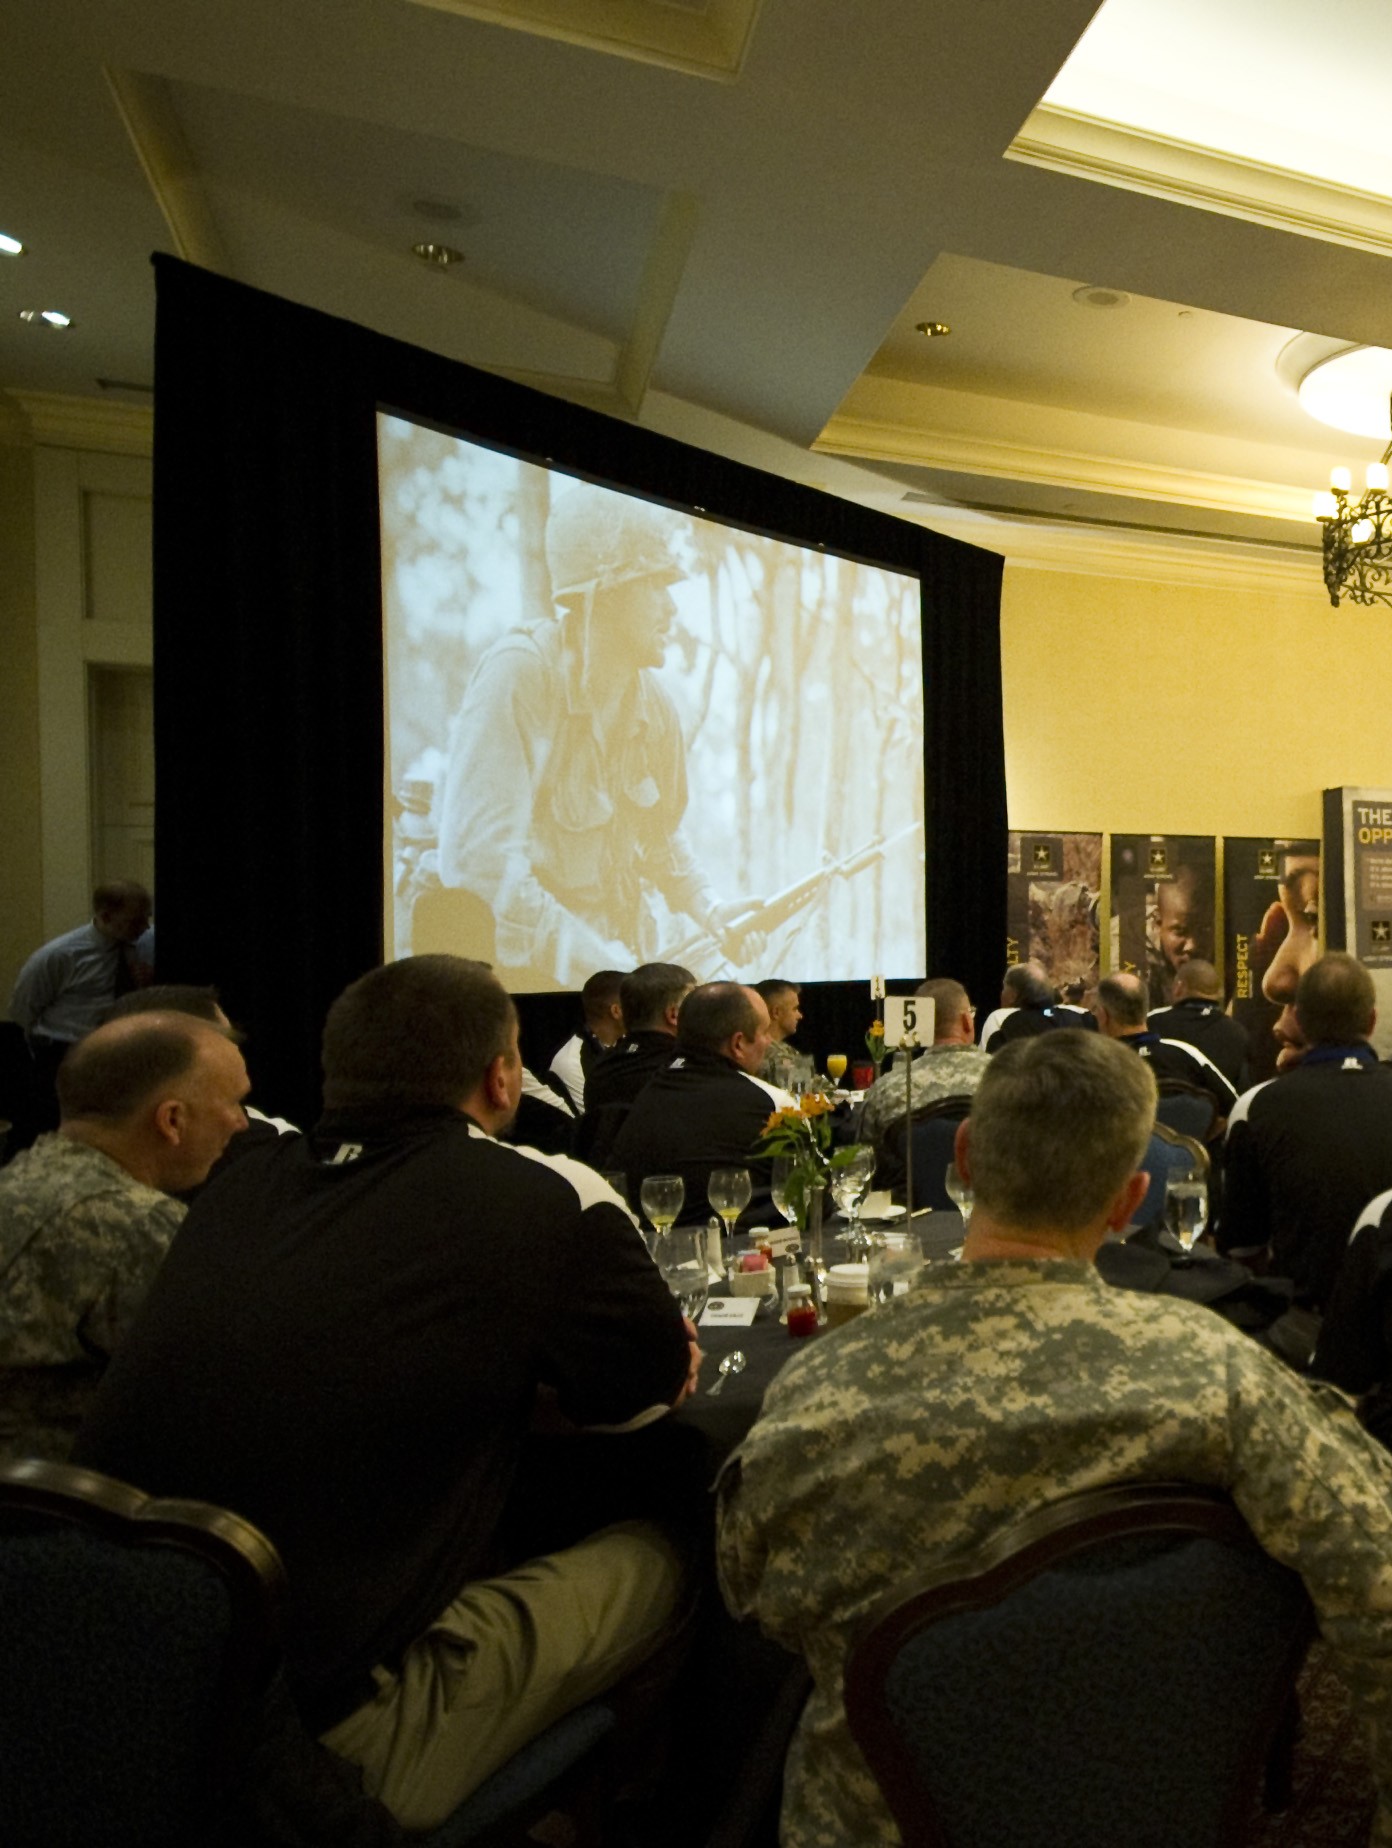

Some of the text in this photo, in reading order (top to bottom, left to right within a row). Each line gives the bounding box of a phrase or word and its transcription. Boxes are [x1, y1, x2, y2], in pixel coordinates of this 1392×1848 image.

[1358, 807, 1392, 825] THE
[1236, 933, 1249, 999] RESPECT
[903, 1000, 916, 1031] 5
